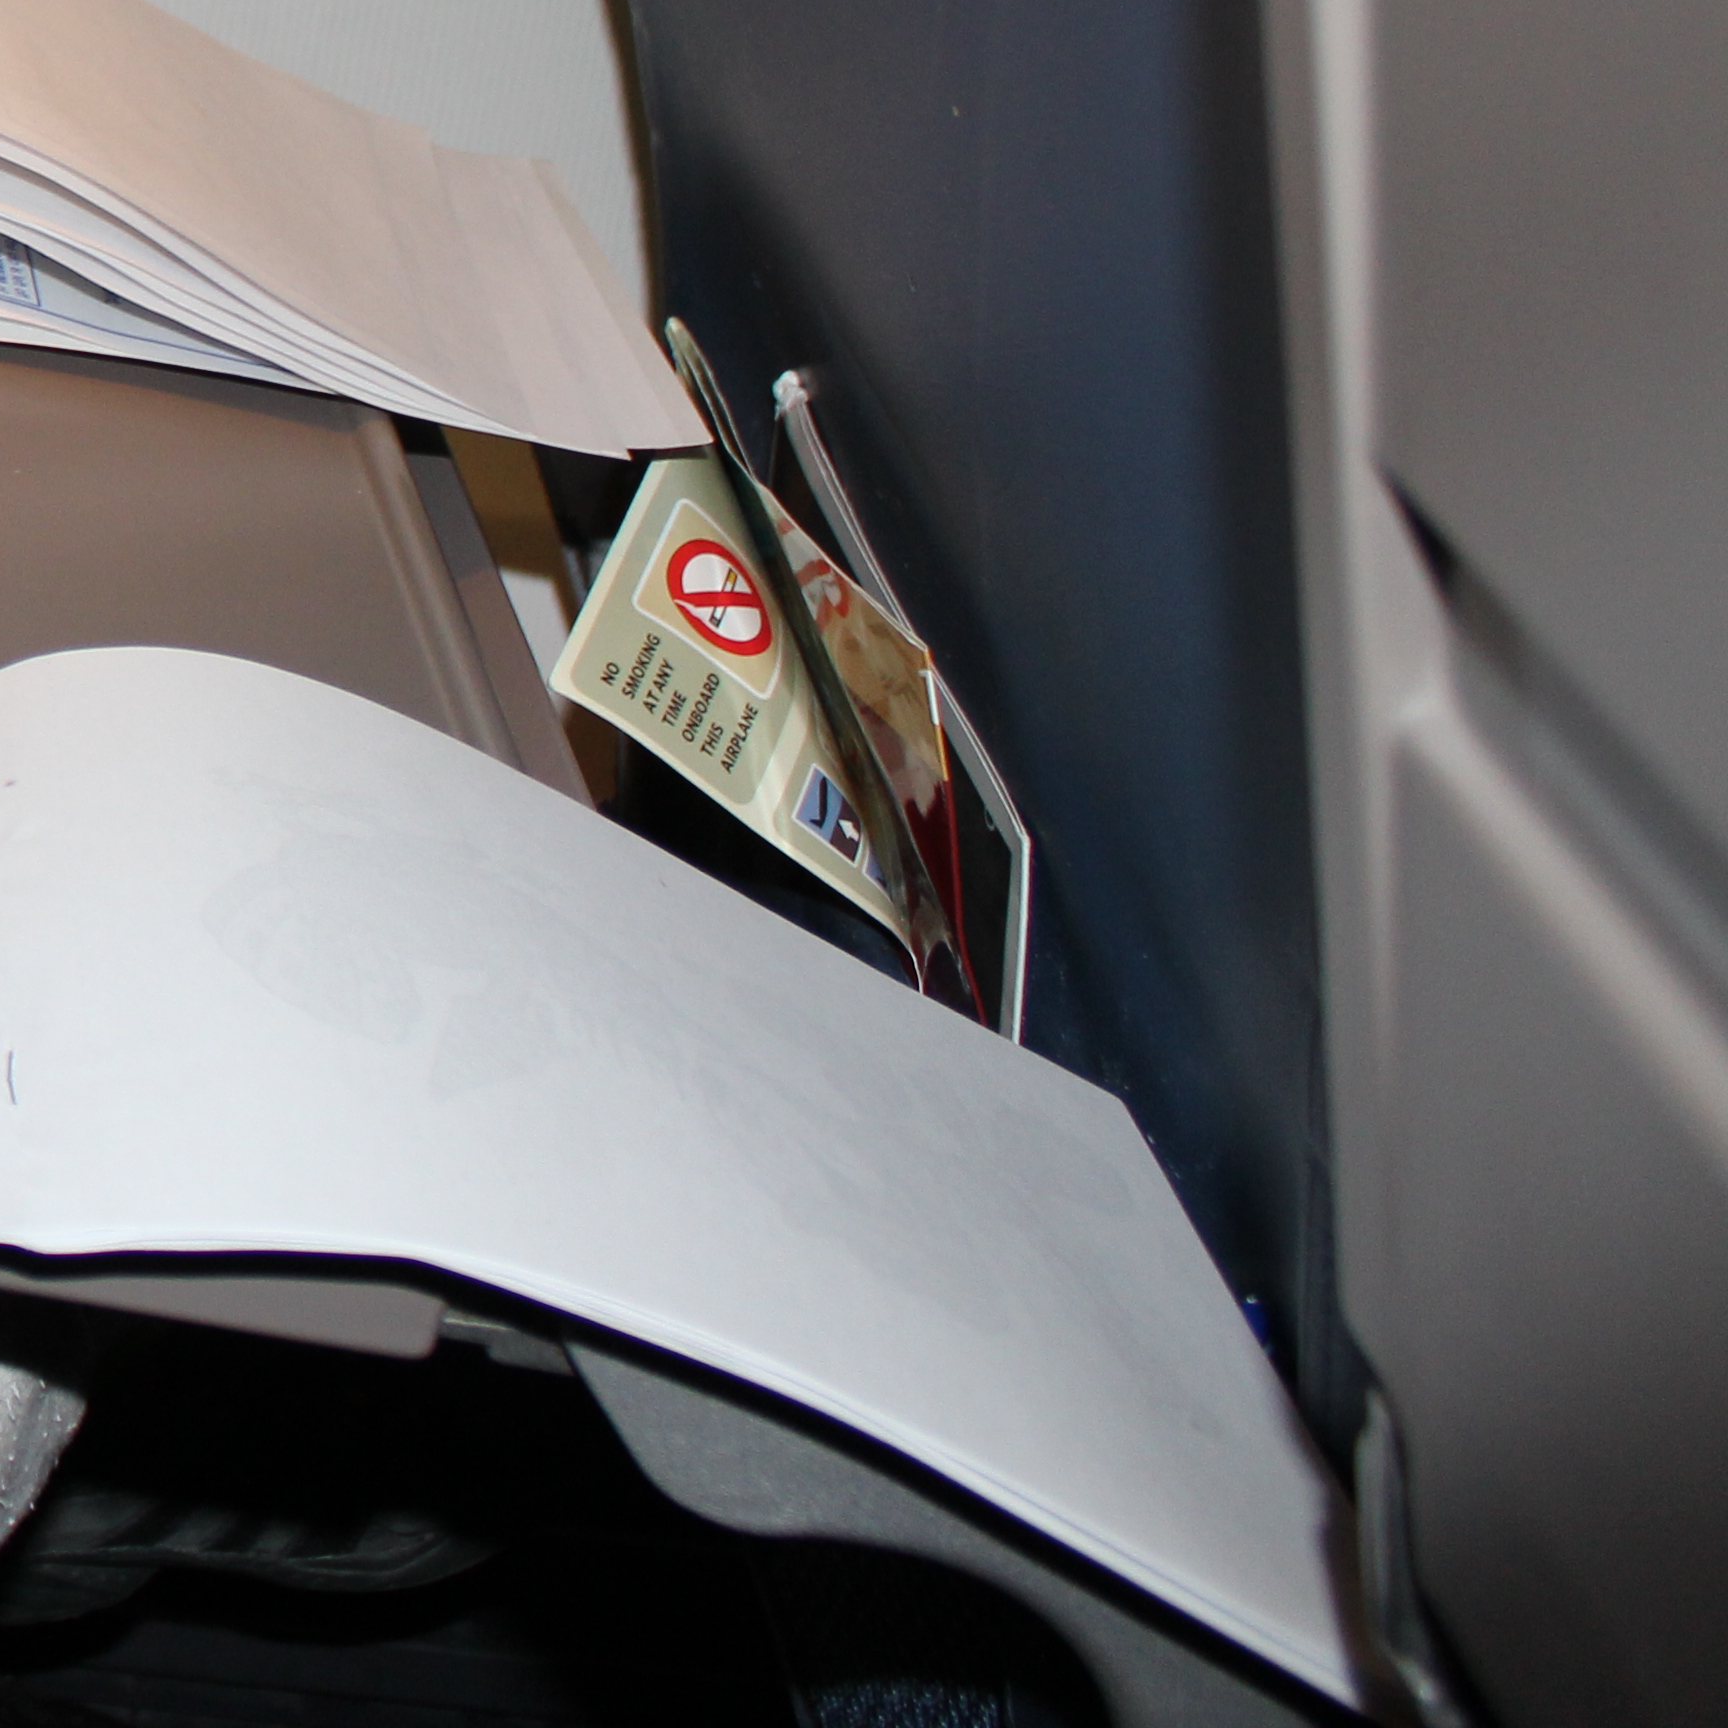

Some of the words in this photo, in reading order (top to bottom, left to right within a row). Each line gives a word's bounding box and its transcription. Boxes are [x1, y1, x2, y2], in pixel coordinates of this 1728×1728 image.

[600, 662, 620, 686] NO
[621, 633, 660, 700] SMOKING
[651, 657, 675, 694] ANY
[642, 688, 661, 715] AT
[660, 689, 688, 727] TIME
[681, 672, 721, 743] ONBOARD
[699, 721, 725, 758] THIS
[719, 702, 759, 775] AIRPLANE
